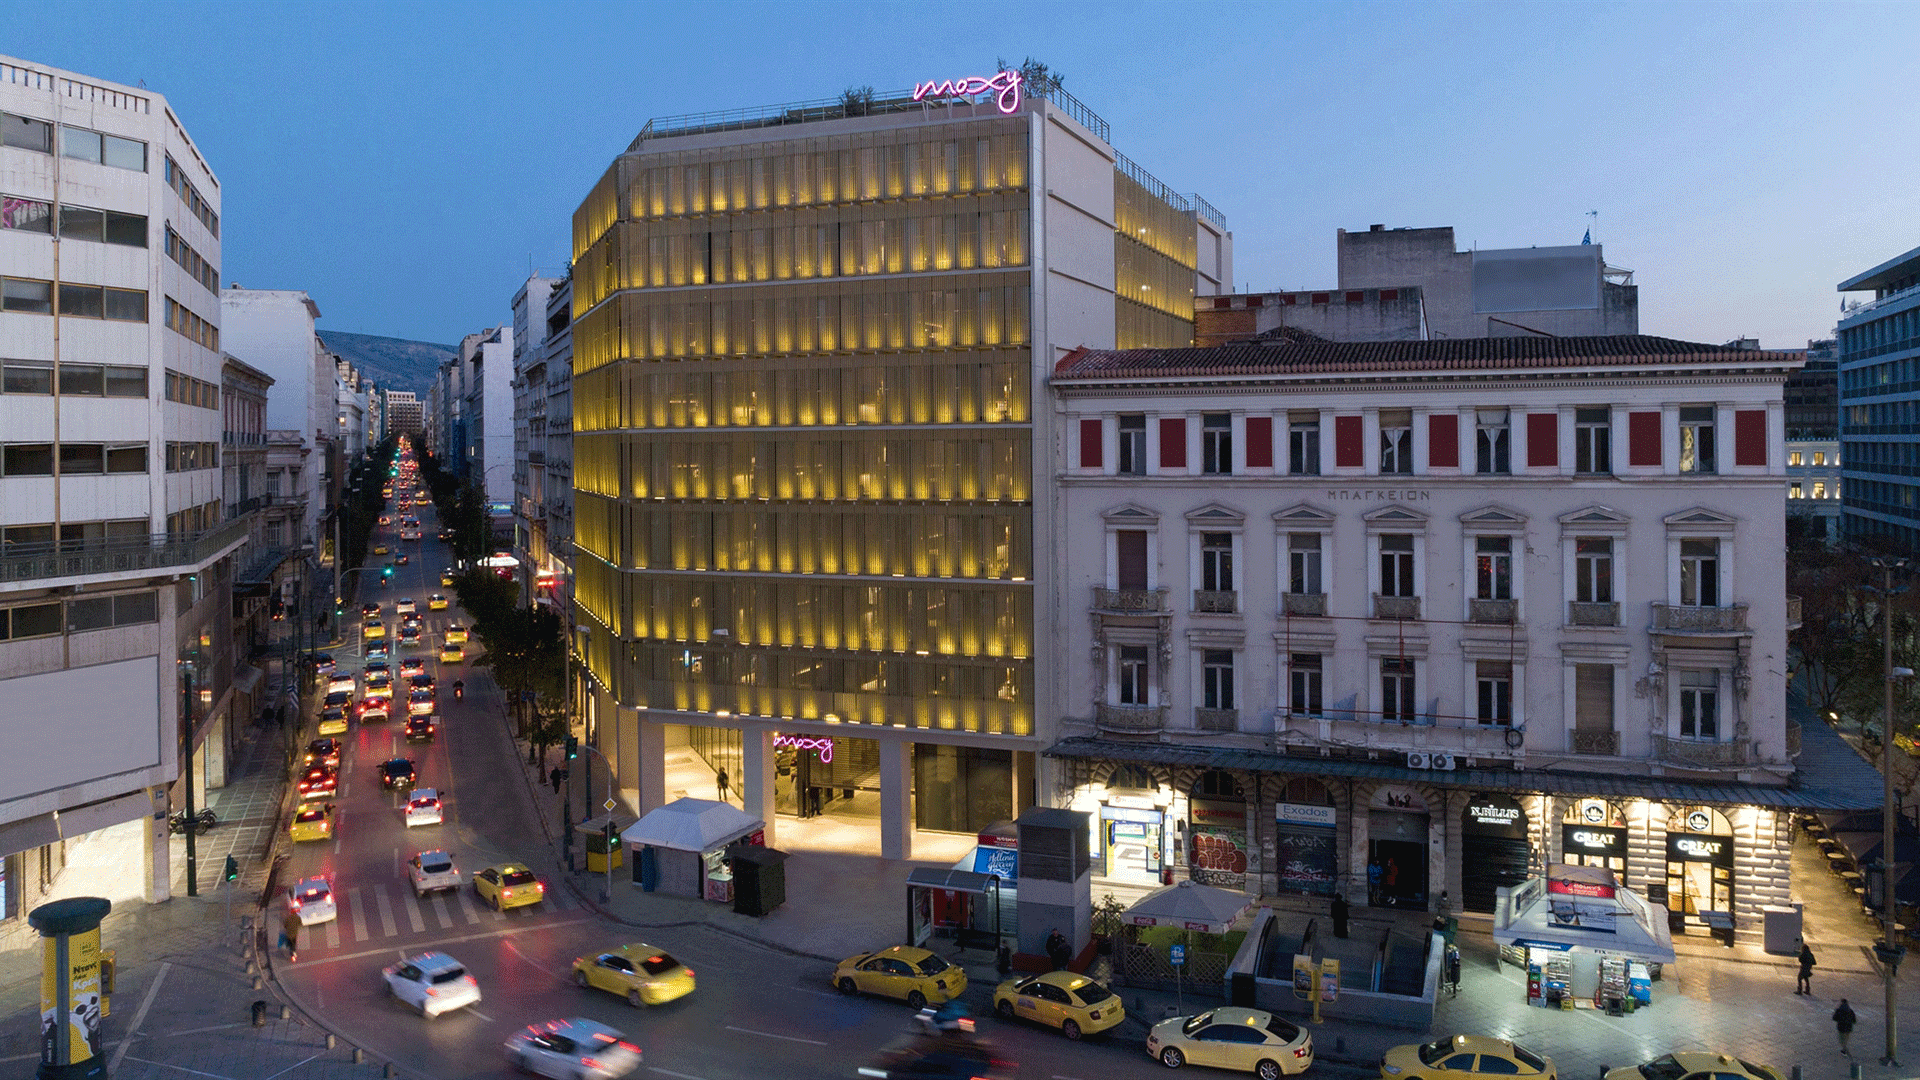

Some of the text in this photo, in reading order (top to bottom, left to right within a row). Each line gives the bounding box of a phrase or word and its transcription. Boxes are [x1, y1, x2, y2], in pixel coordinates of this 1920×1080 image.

[914, 71, 1022, 114] moxy
[1328, 490, 1430, 500] ΜΠΑΓΚΕΙΟΝ
[773, 735, 834, 763] moxy
[1283, 804, 1328, 817] Exodos
[1573, 831, 1616, 844] GREAT
[1677, 839, 1722, 853] GREAT
